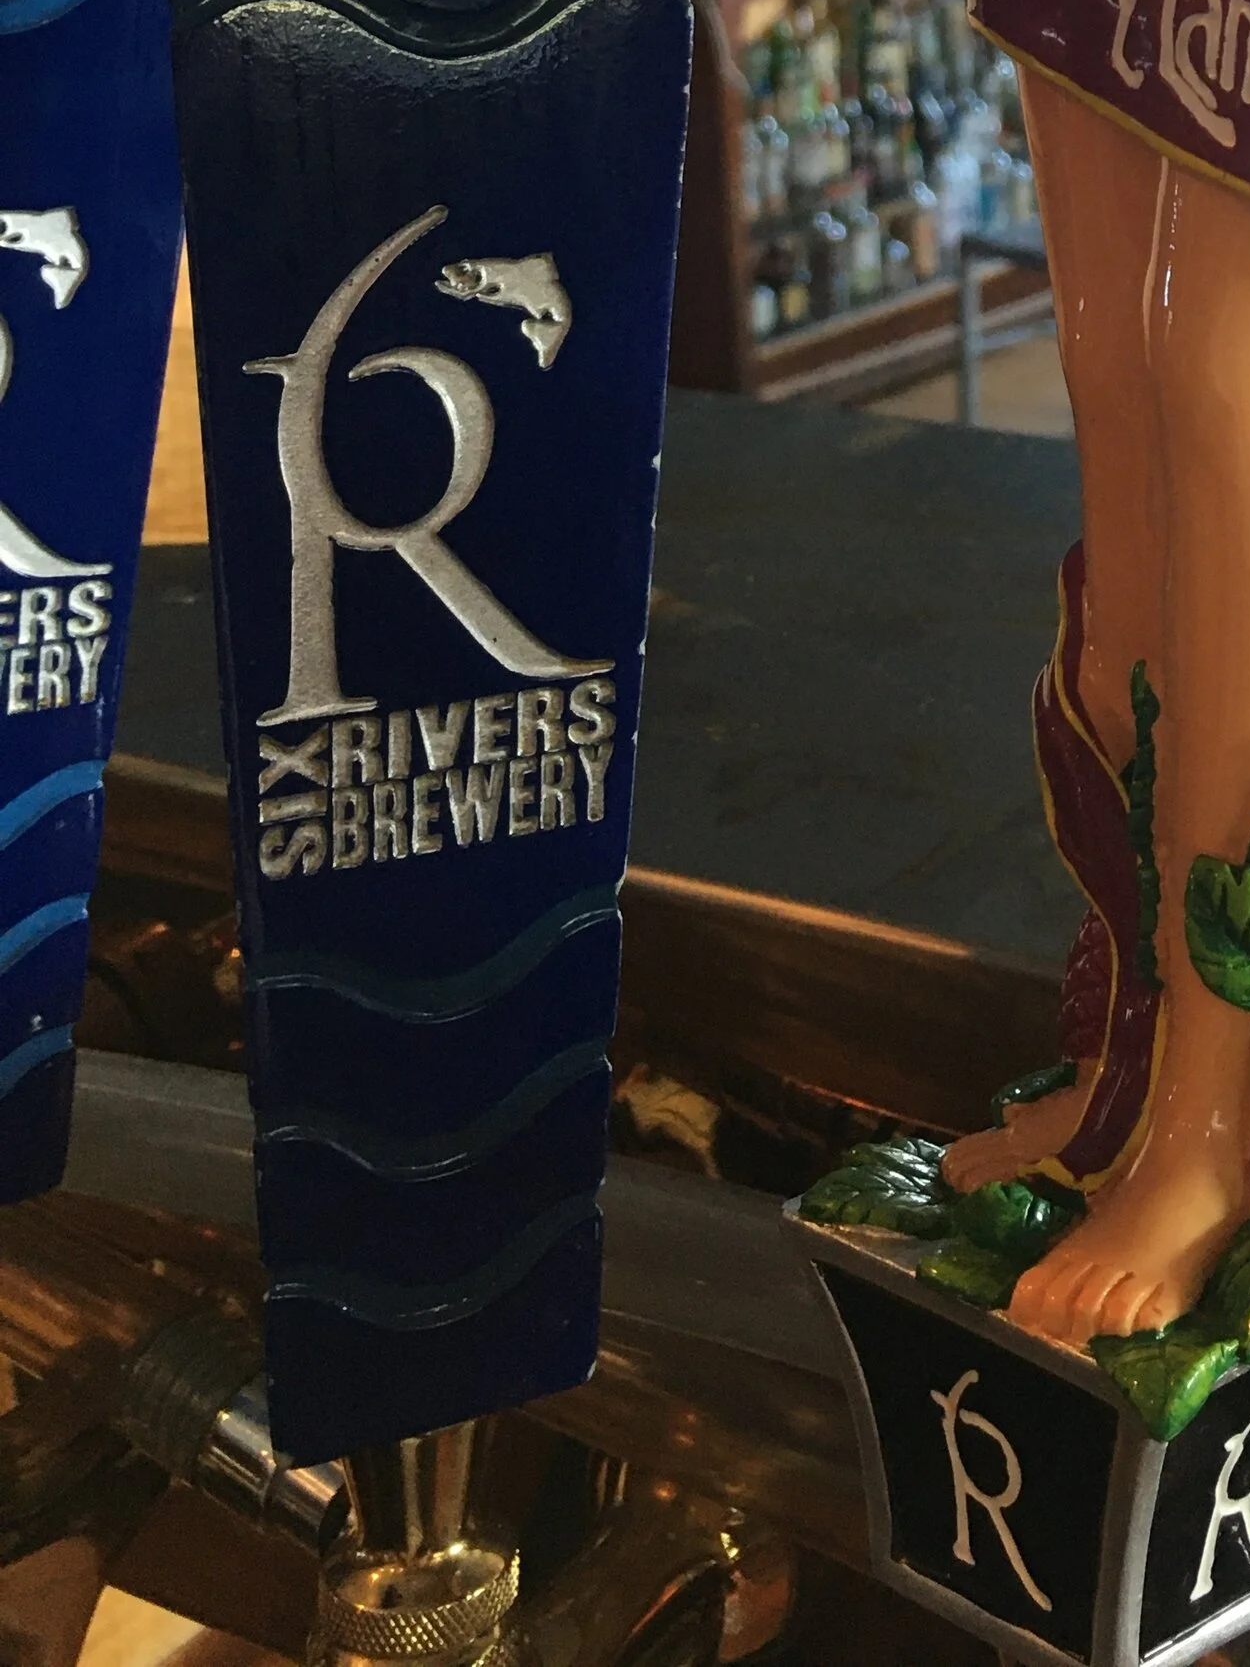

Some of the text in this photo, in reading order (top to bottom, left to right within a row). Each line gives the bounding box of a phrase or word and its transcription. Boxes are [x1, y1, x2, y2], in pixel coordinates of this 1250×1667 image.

[0, 635, 109, 716] ERY
[331, 677, 617, 789] RIVERS
[258, 722, 329, 881] SIX
[331, 742, 614, 871] BREWERY
